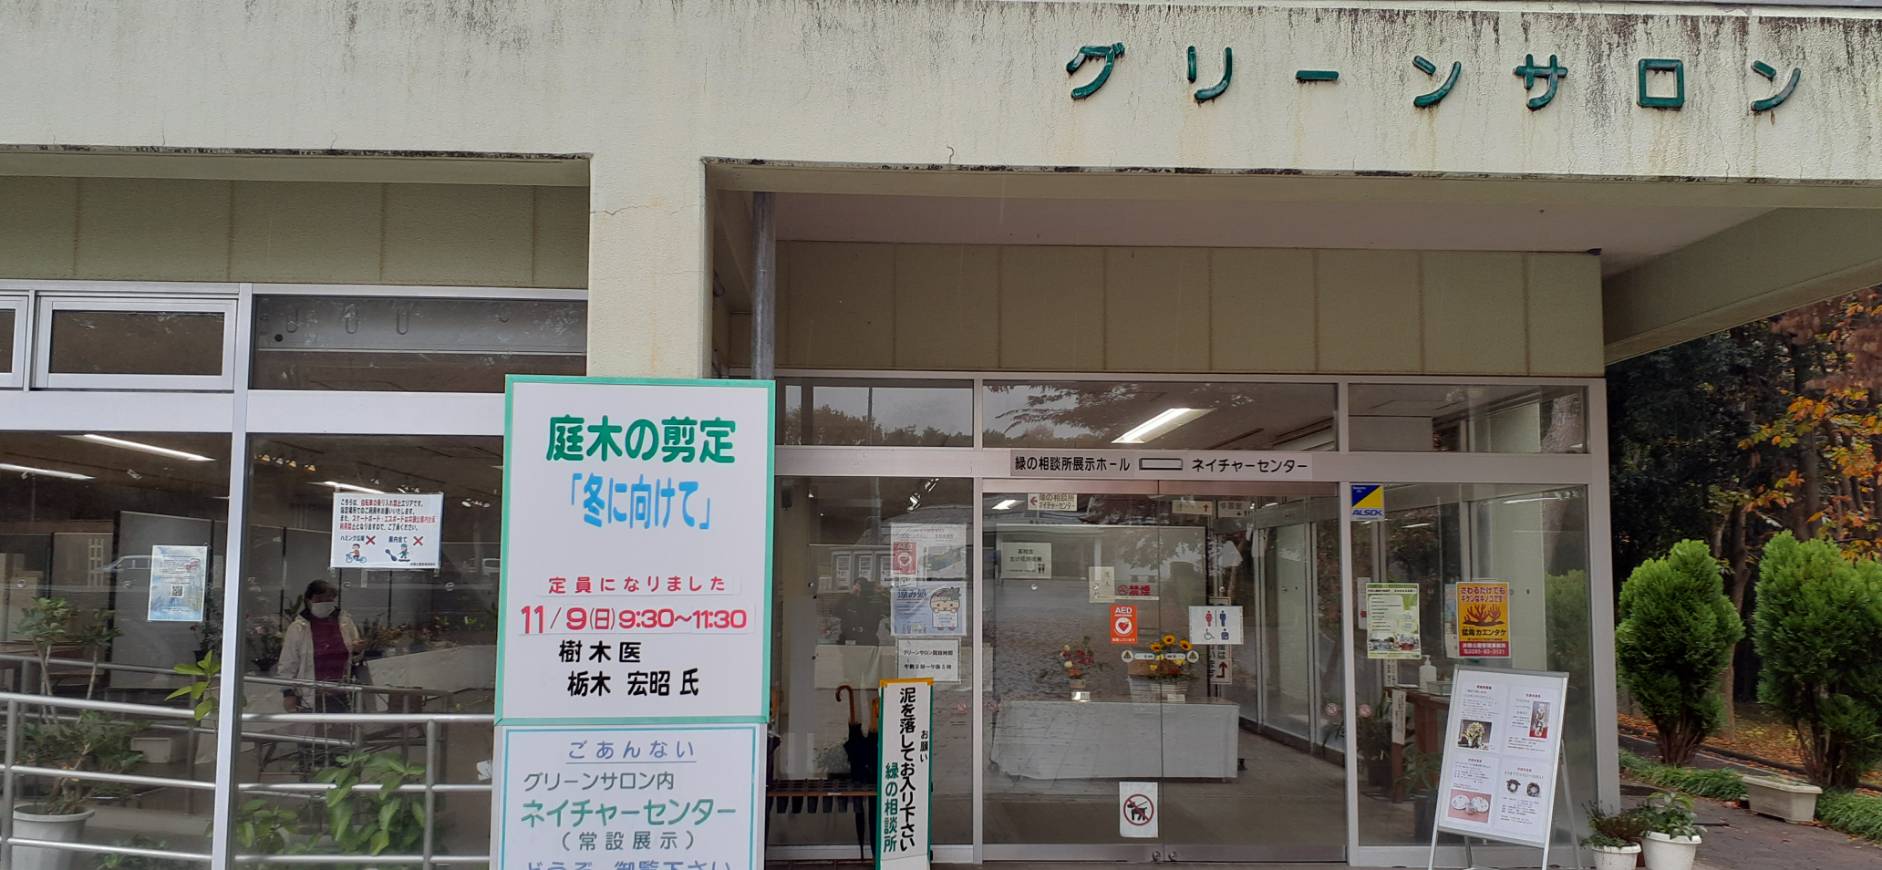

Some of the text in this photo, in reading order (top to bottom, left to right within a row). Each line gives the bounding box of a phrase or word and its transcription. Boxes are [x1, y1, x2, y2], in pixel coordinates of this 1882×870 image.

[1066, 43, 1802, 111] グリーンサロン
[546, 414, 736, 464] 庭木の剪定
[1191, 459, 1309, 473] ネイチャーセンター
[571, 472, 711, 530] 「冬に向けて」
[548, 576, 725, 594] 定員になりました
[559, 639, 642, 663] 樹木医
[567, 668, 700, 697] 栃木 宏昭 氏
[567, 740, 695, 760] ごあんない
[523, 771, 675, 792] グリーンサロン内
[900, 687, 916, 852] 泥を落してお入り下さい
[520, 799, 737, 828] ネイチャーセンター
[883, 762, 899, 853] 緑の相談所
